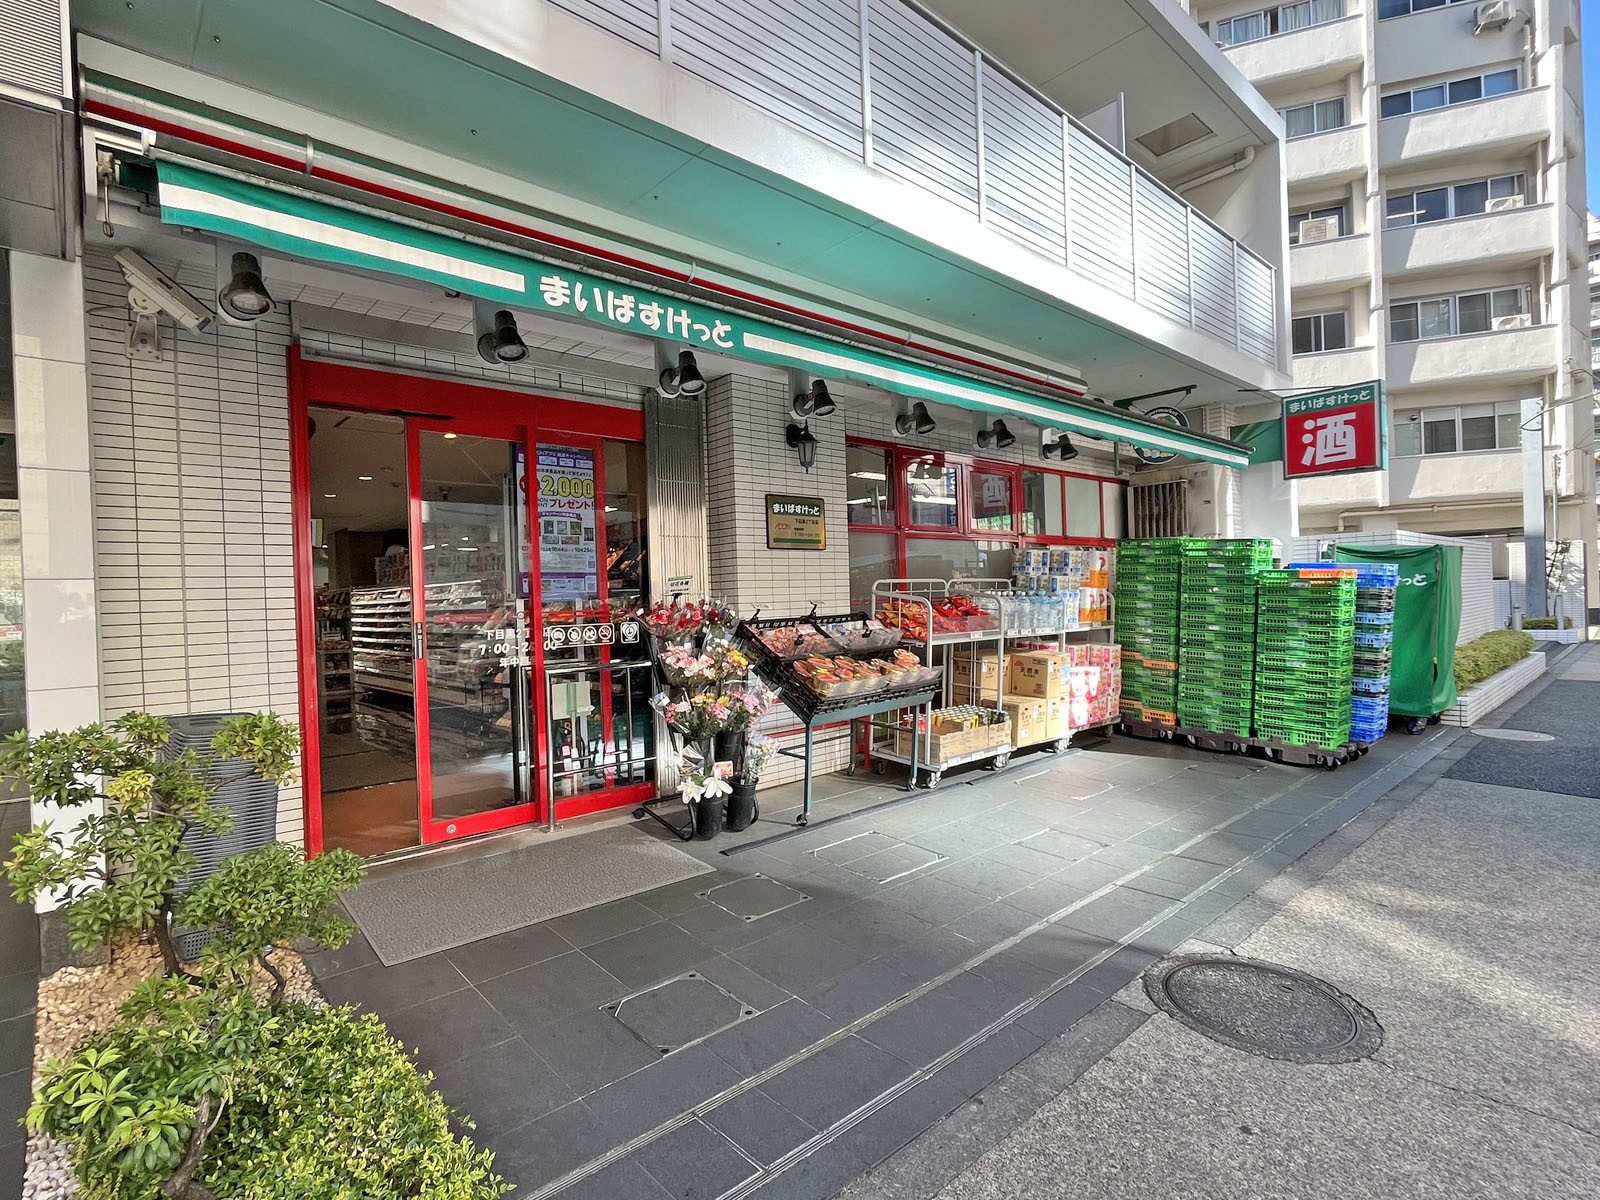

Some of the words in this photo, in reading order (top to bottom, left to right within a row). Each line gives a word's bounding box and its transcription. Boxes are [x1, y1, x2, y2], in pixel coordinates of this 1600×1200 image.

[540, 275, 734, 348] まいばすけっと
[1289, 390, 1371, 413] まいばすけっと
[1301, 412, 1356, 466] 酒
[541, 475, 594, 499] 2,000
[772, 503, 820, 515] まいばすけっと
